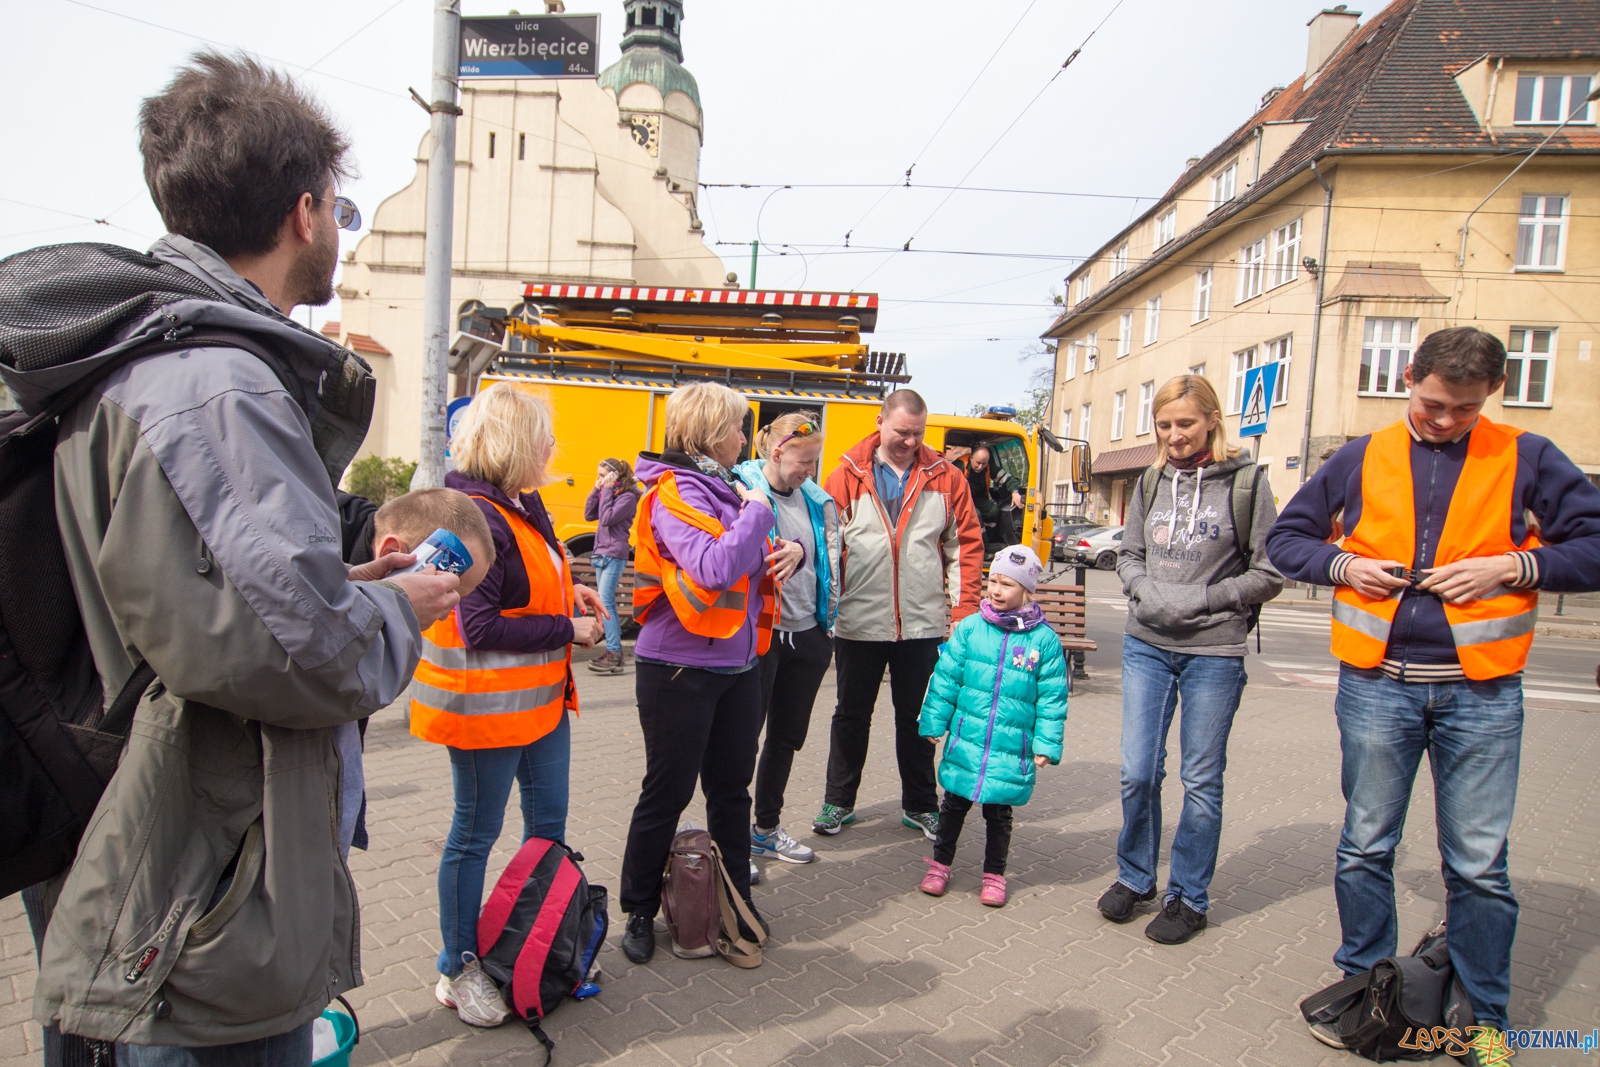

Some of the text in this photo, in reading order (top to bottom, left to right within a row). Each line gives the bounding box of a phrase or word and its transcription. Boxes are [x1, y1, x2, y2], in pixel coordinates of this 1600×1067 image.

[515, 21, 539, 31] ulica
[464, 37, 590, 60] Wierzbięcice
[568, 63, 581, 73] 44
[1176, 494, 1190, 509] The
[1151, 510, 1183, 525] Plan
[1147, 545, 1202, 562] STATE CENTER
